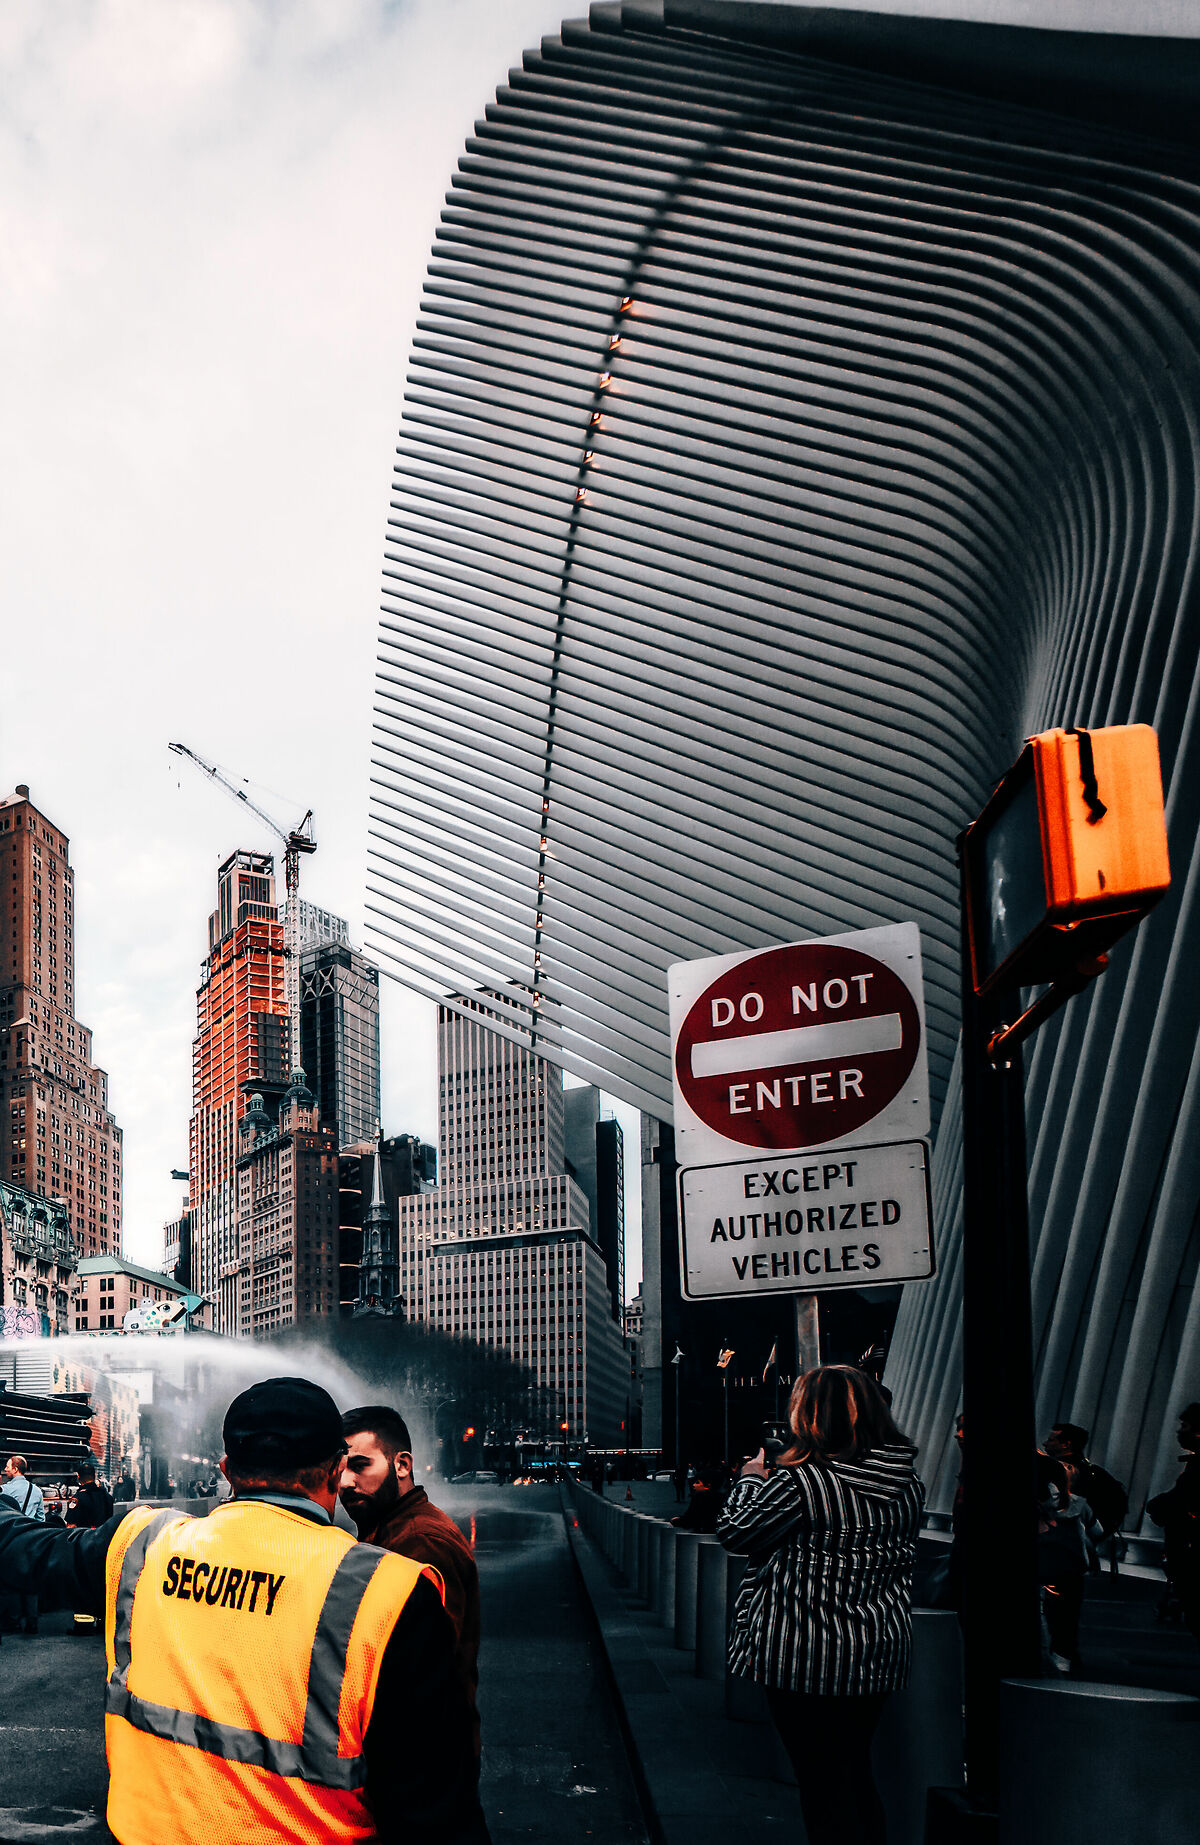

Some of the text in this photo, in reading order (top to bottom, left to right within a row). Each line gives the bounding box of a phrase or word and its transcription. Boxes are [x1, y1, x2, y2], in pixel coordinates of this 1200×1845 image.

[711, 973, 874, 1028] DO NOT
[728, 1068, 865, 1115] ENTER
[743, 1161, 858, 1199] EXCEPT
[710, 1199, 902, 1243] AUTHORIZED
[731, 1243, 882, 1281] VEHICLES
[720, 1376, 759, 1387] THE
[162, 1556, 286, 1616] SECURITY
